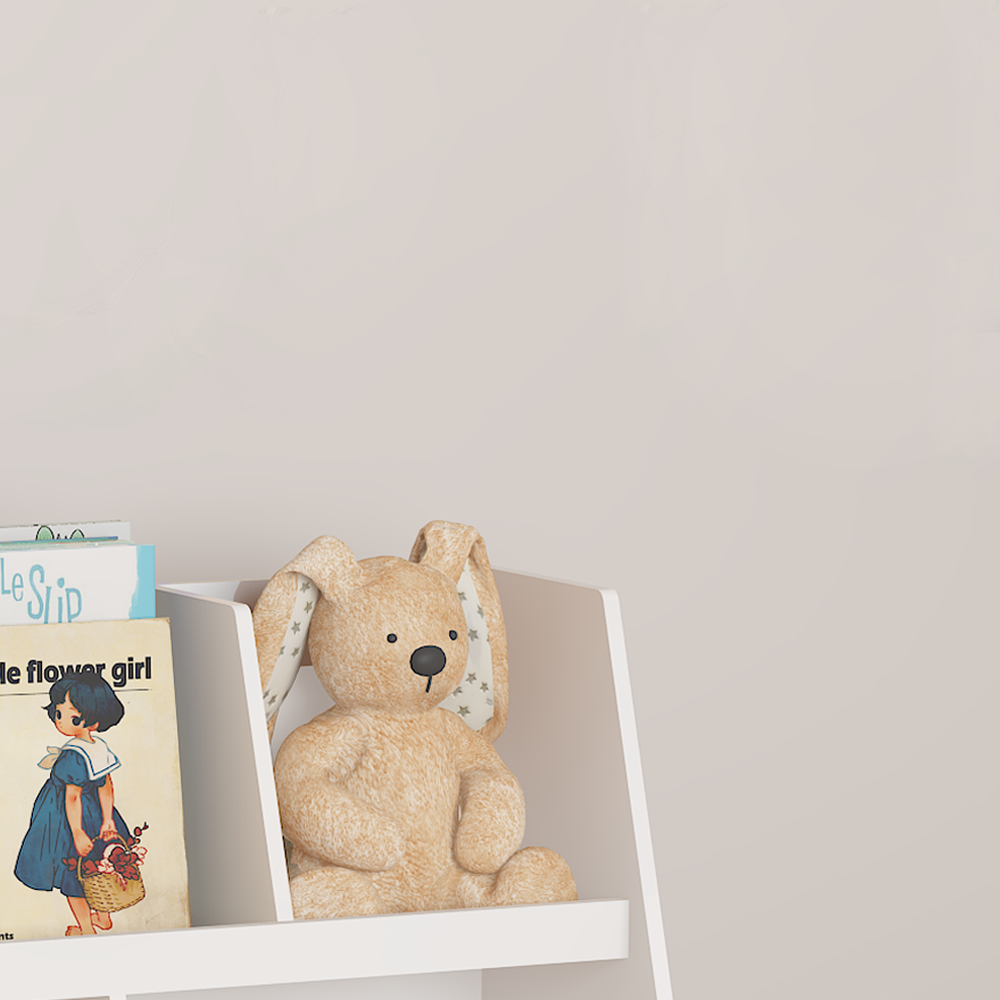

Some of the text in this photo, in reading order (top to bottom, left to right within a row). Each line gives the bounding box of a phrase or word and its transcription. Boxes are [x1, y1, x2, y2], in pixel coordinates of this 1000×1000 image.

[0, 557, 82, 624] Le Slip
[111, 656, 152, 688] girl
